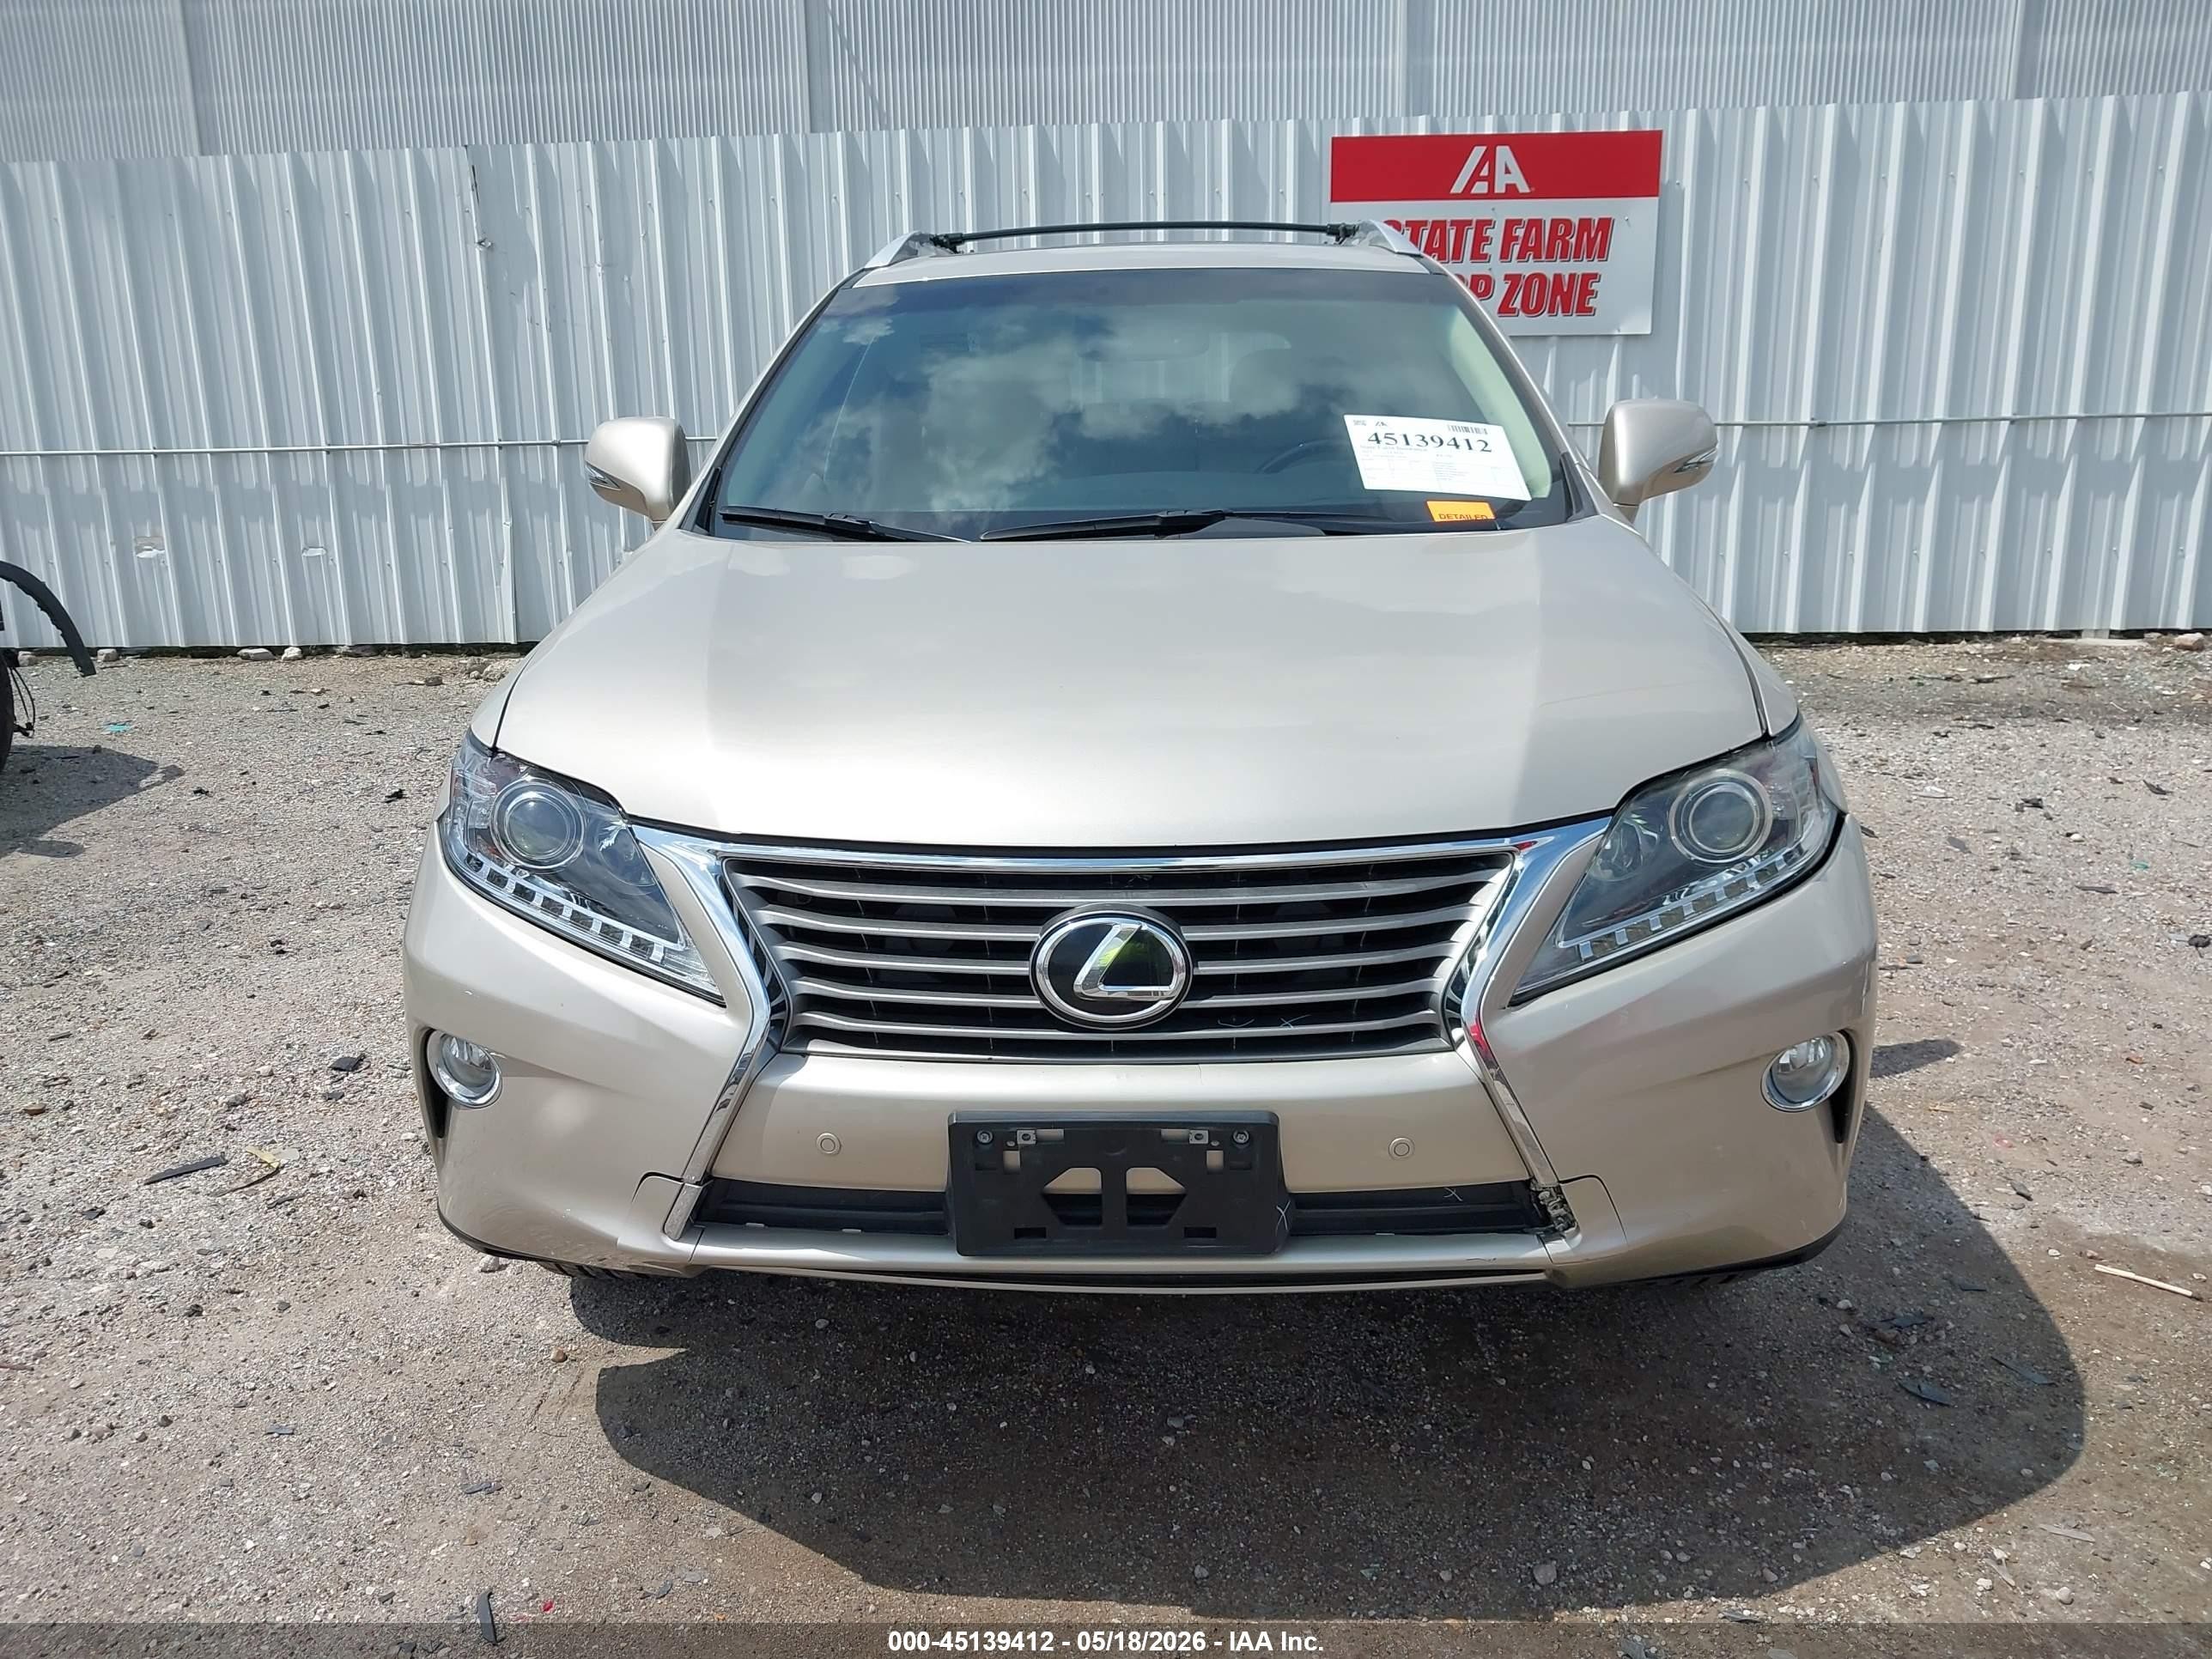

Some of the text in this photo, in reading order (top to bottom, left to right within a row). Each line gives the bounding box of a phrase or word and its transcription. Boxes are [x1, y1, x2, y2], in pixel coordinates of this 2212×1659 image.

[1499, 216, 1614, 263] FARM
[1497, 272, 1601, 318] ZONE
[1367, 432, 1492, 453] 45139412
